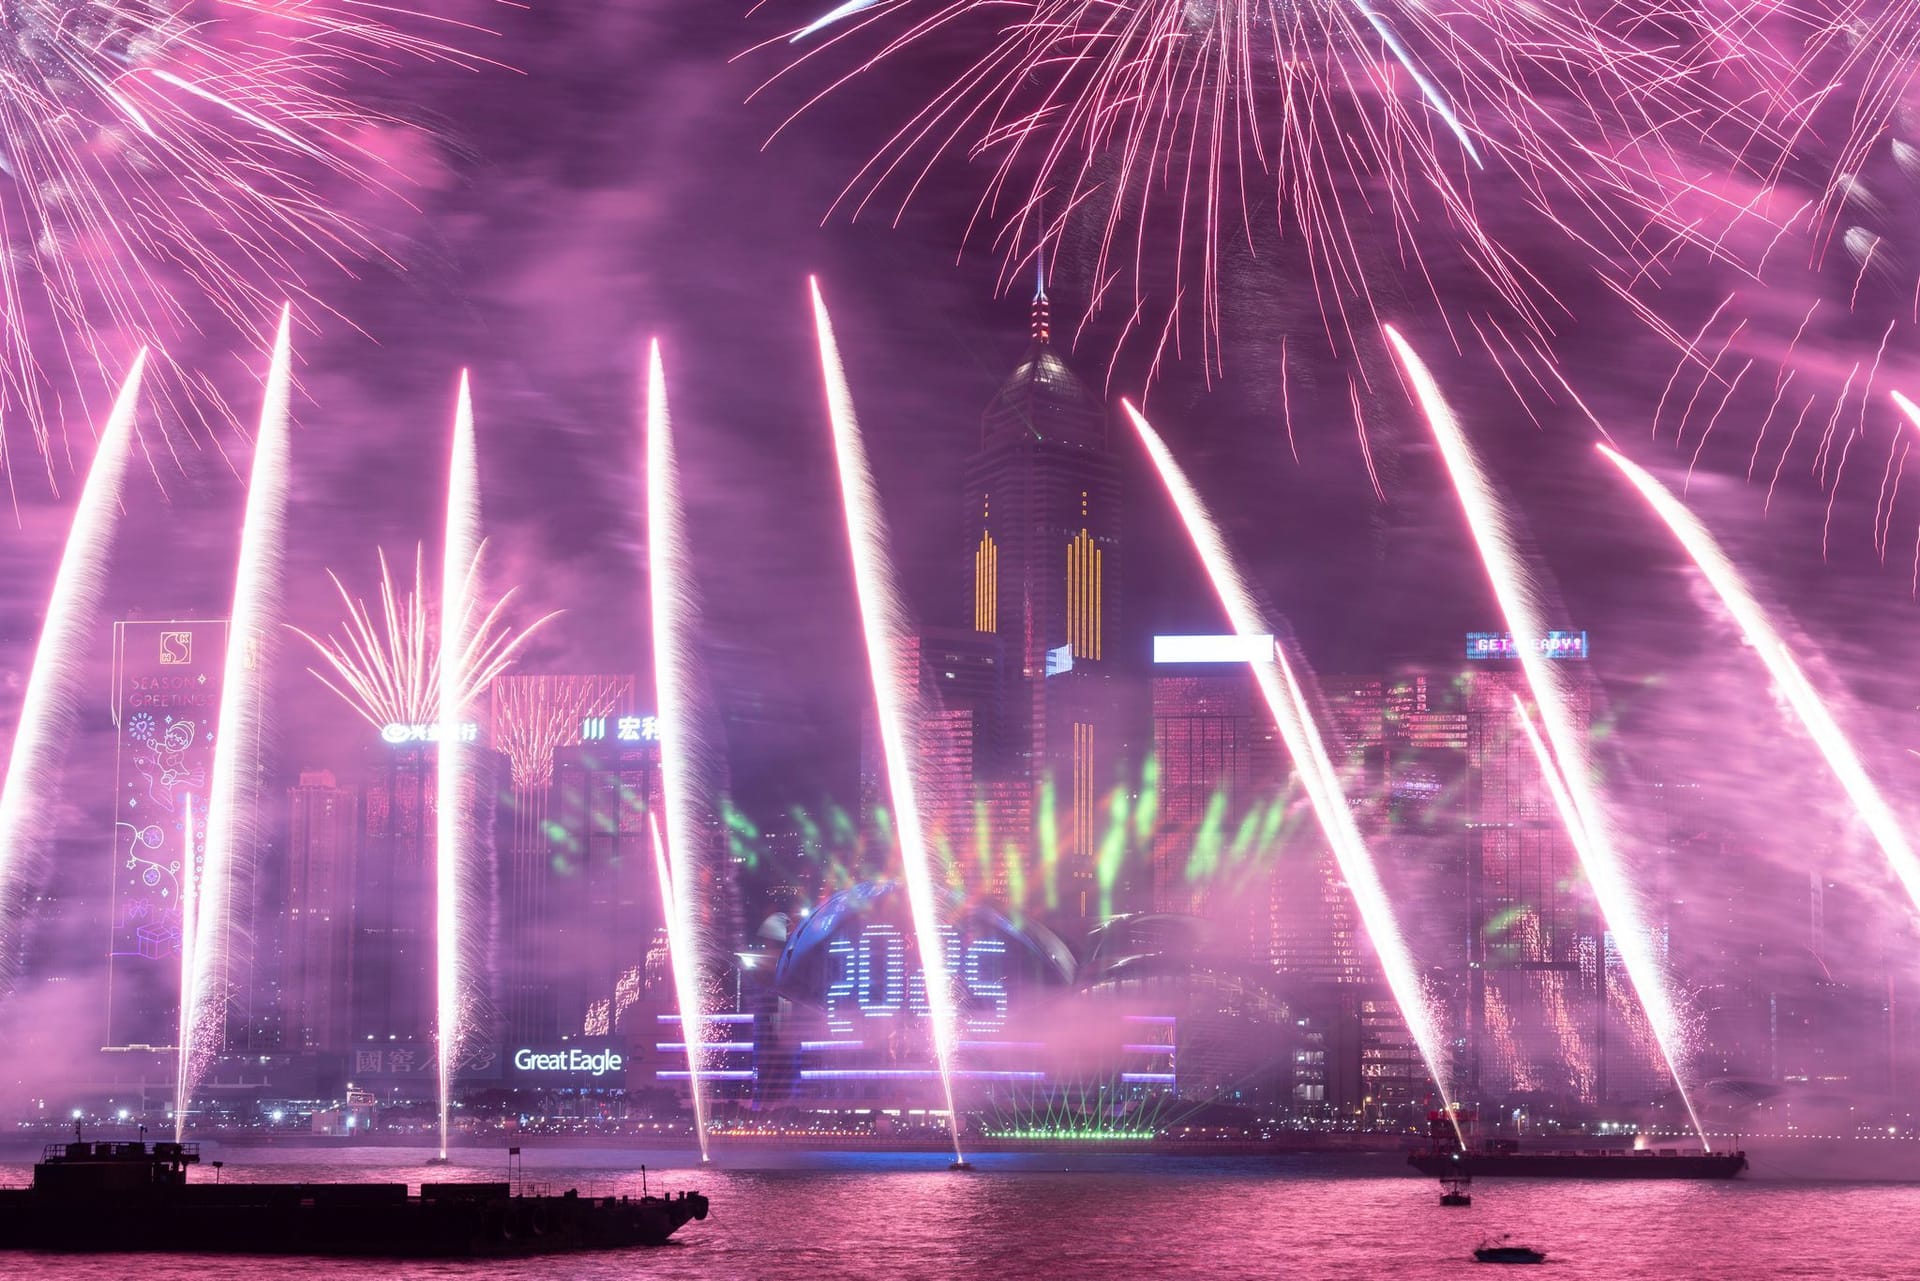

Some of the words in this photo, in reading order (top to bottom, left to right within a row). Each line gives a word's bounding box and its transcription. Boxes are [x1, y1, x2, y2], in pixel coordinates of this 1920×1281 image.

[1478, 639, 1508, 651] GET
[1527, 638, 1582, 650] EADY!
[128, 694, 217, 707] GREETINGS
[514, 1048, 568, 1071] Great
[569, 1048, 622, 1076] Eagle
